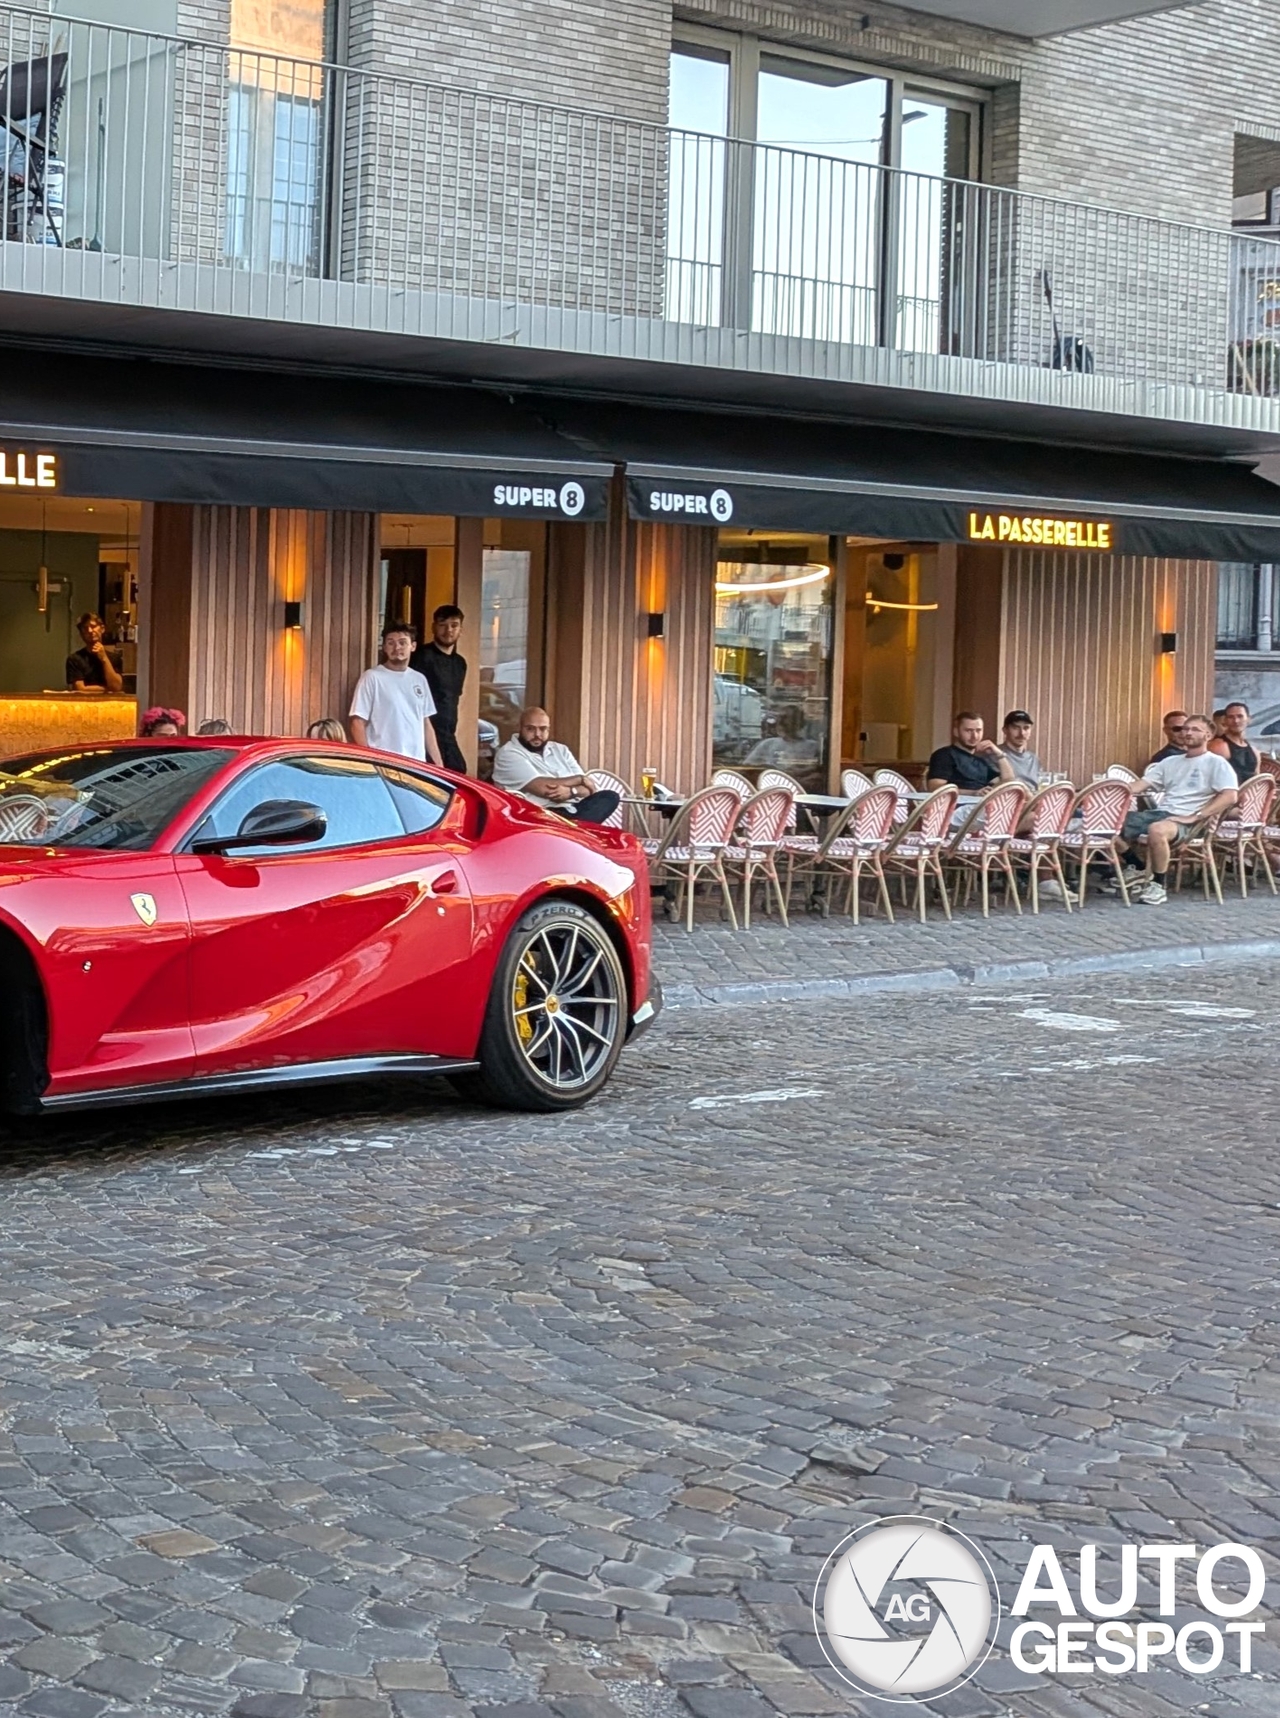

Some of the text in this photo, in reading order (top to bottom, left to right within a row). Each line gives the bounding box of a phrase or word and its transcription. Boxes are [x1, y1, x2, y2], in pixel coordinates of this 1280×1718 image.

[493, 484, 557, 508] SUPER
[650, 491, 708, 514] SUPER
[970, 513, 1110, 548] LA PASSERELLE
[531, 906, 577, 925] P ZERO
